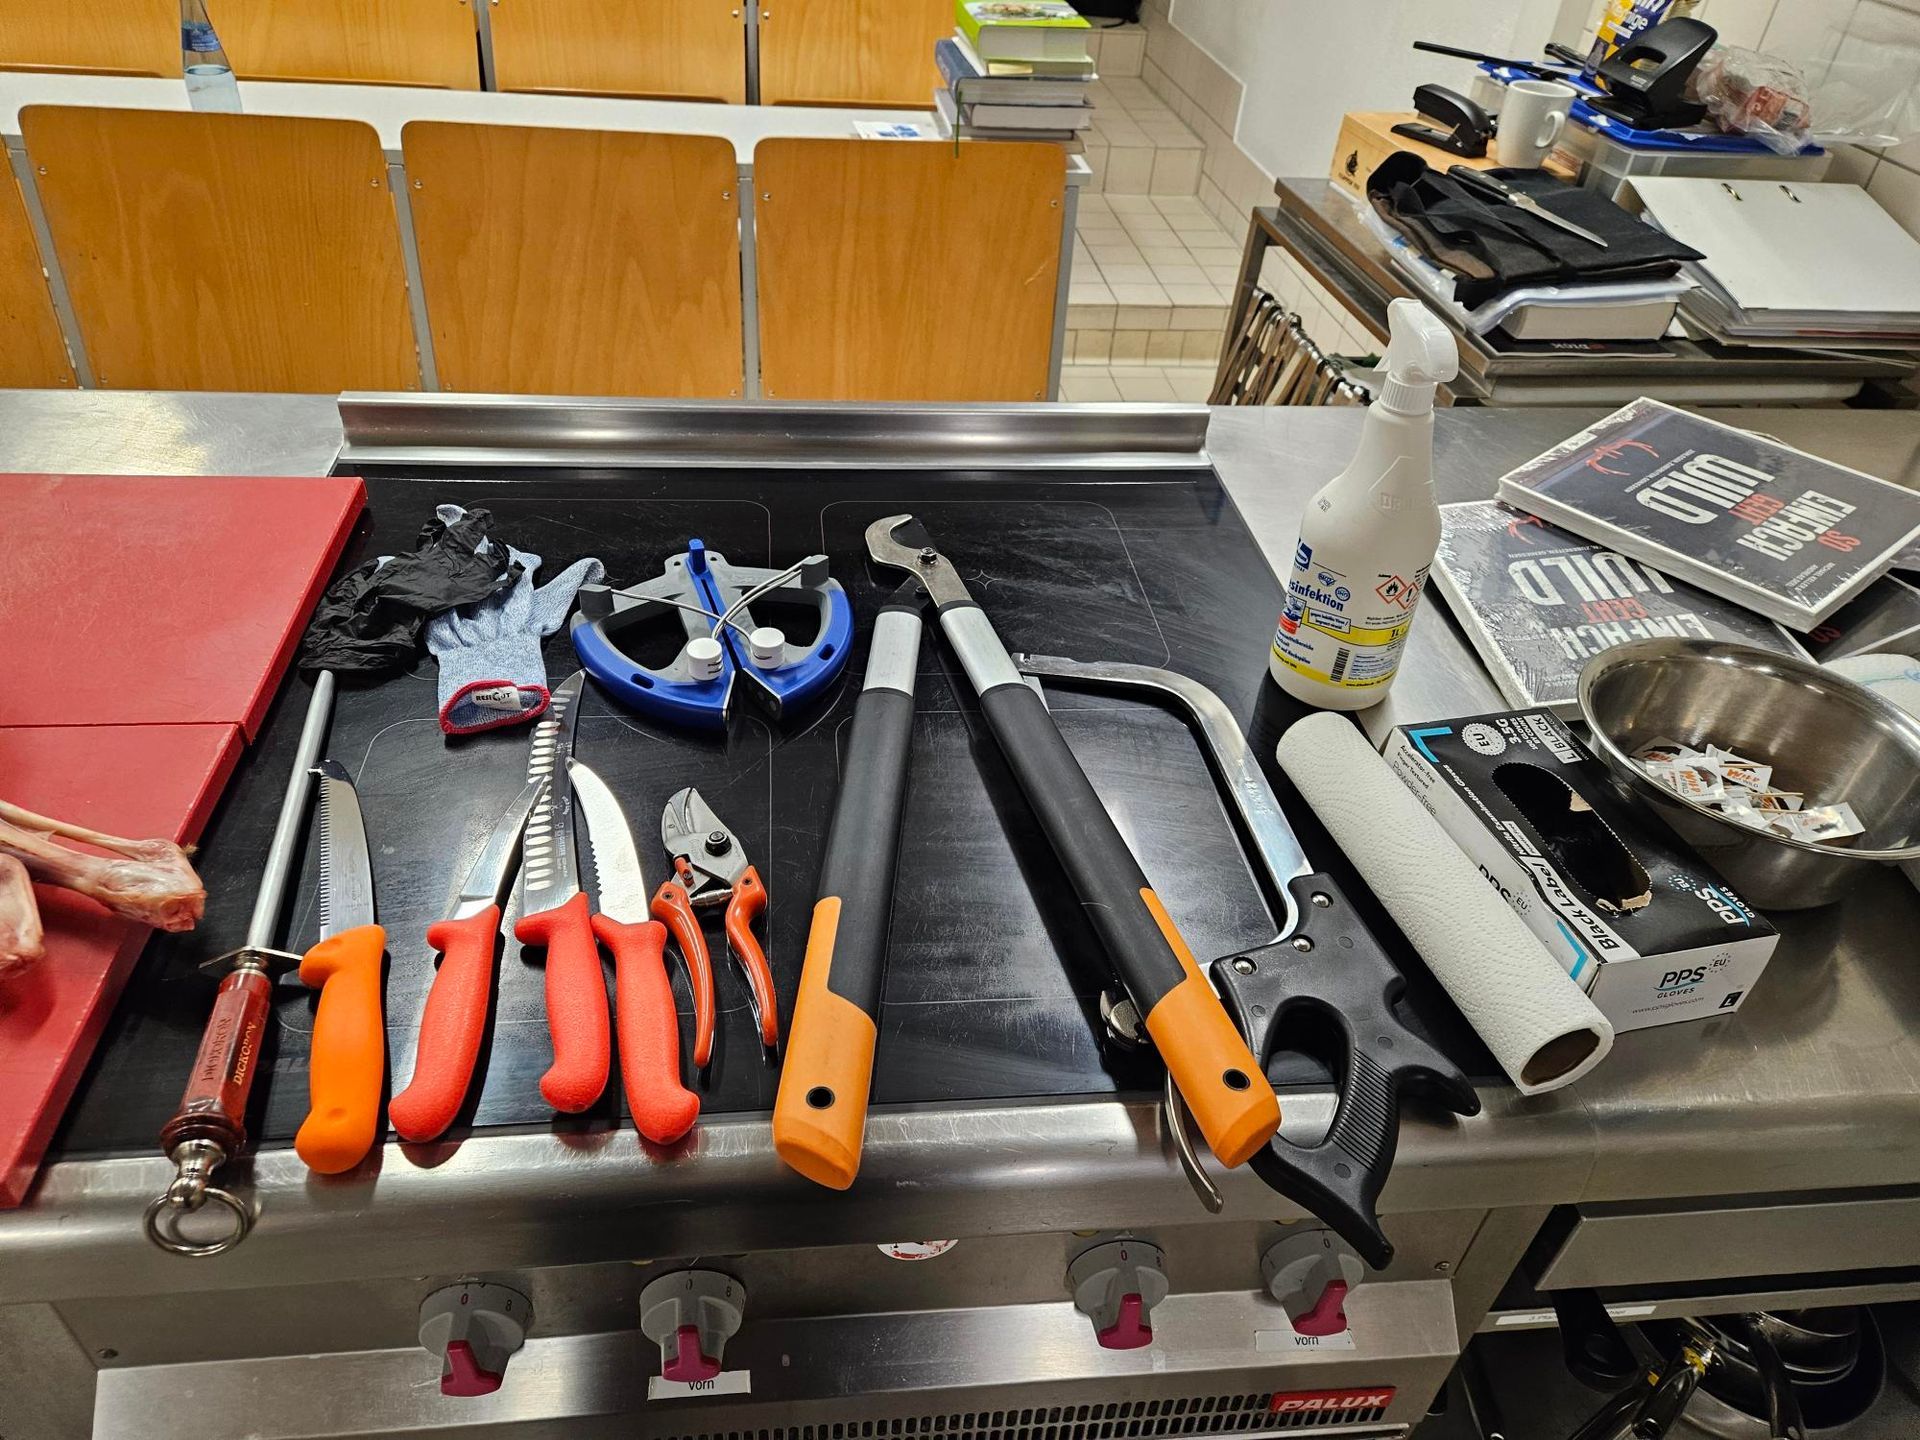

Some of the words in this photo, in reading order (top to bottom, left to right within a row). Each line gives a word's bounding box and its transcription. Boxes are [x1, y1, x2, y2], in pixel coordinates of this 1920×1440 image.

[1635, 453, 1776, 525] WILD
[1728, 493, 1786, 527] GEHT
[1736, 489, 1857, 562] EINFACH
[1816, 529, 1862, 553] SO
[1508, 551, 1675, 606] WILD
[1580, 597, 1649, 624] GEHT
[1473, 732, 1491, 748] EU
[1495, 719, 1522, 745] 3.5G
[1532, 716, 1567, 749] BLACK
[1443, 764, 1466, 787] Gloves
[1464, 785, 1504, 832] Examination
[1502, 830, 1528, 856] Nitrile
[1531, 861, 1576, 907] Label
[1674, 877, 1690, 889] EU
[1516, 897, 1528, 910] EU
[1694, 887, 1746, 924] PPS
[1719, 886, 1756, 919] GLOVES
[1572, 909, 1621, 951] Black
[1713, 958, 1727, 968] EU
[1659, 966, 1707, 988] PPS
[1656, 987, 1695, 999] GLOVES
[1121, 1249, 1128, 1261] 0
[461, 1292, 468, 1305] 0
[505, 1299, 512, 1312] 8
[1294, 1336, 1319, 1346] vorn
[688, 1379, 714, 1391] vorn
[1278, 1394, 1390, 1412] PALUX
